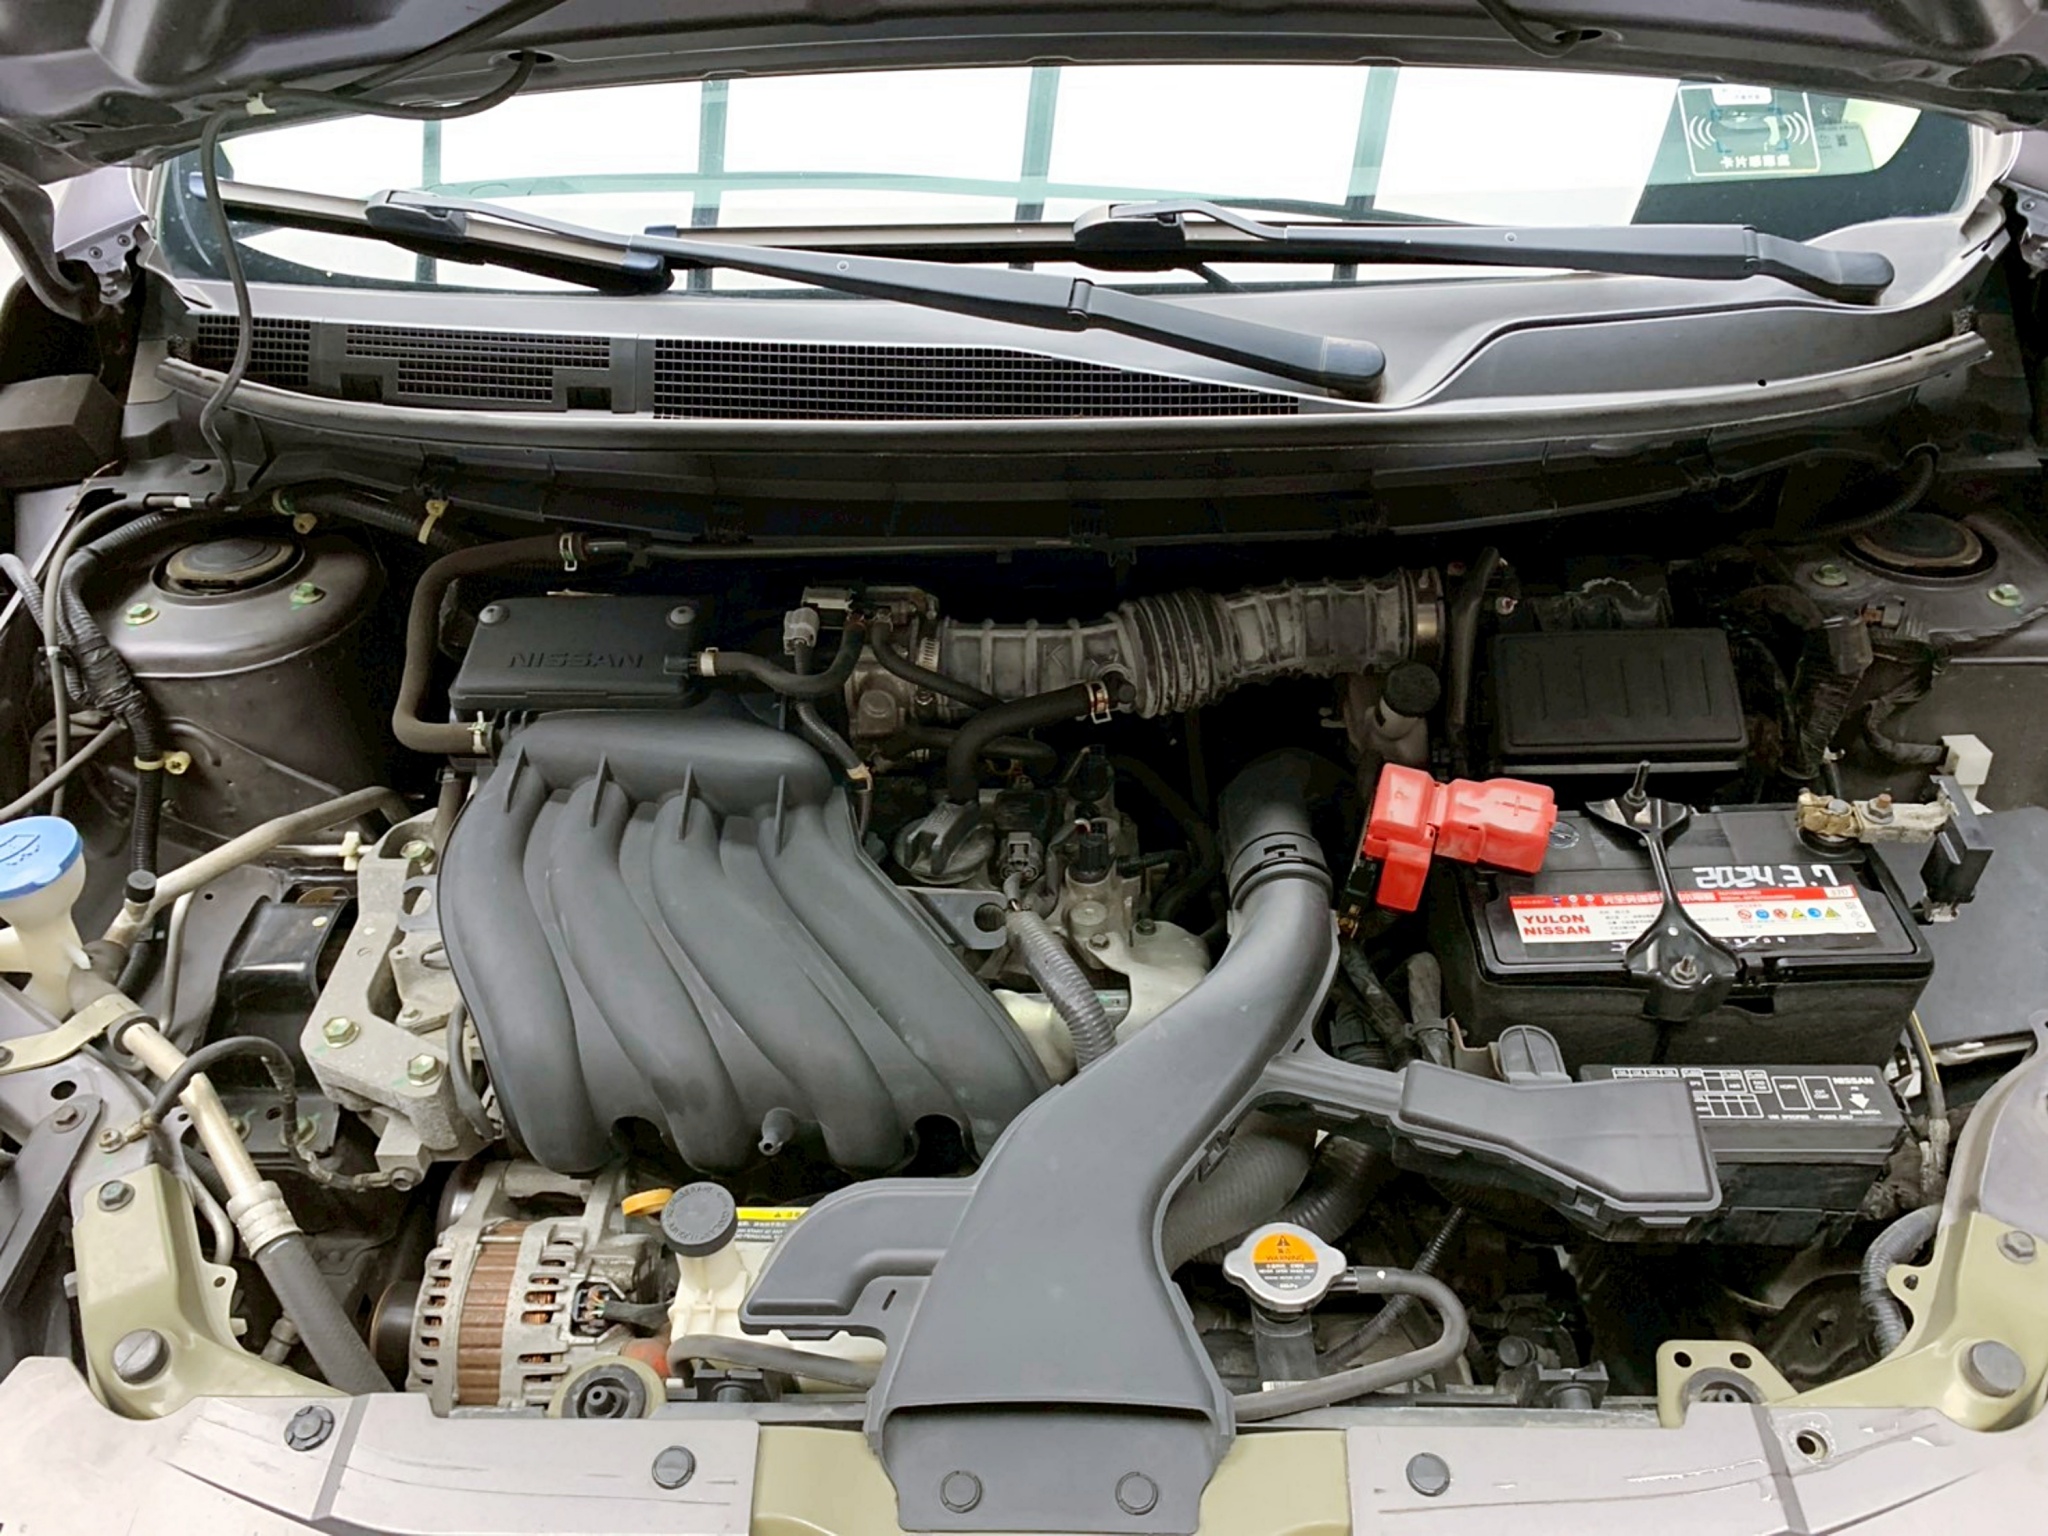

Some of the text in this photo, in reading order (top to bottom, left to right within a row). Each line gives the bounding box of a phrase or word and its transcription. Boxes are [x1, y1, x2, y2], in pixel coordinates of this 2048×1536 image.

[508, 652, 644, 669] NISSAN
[1522, 914, 1585, 925] YULON
[1522, 925, 1591, 936] NISSAN
[1832, 1076, 1875, 1085] NISSAN
